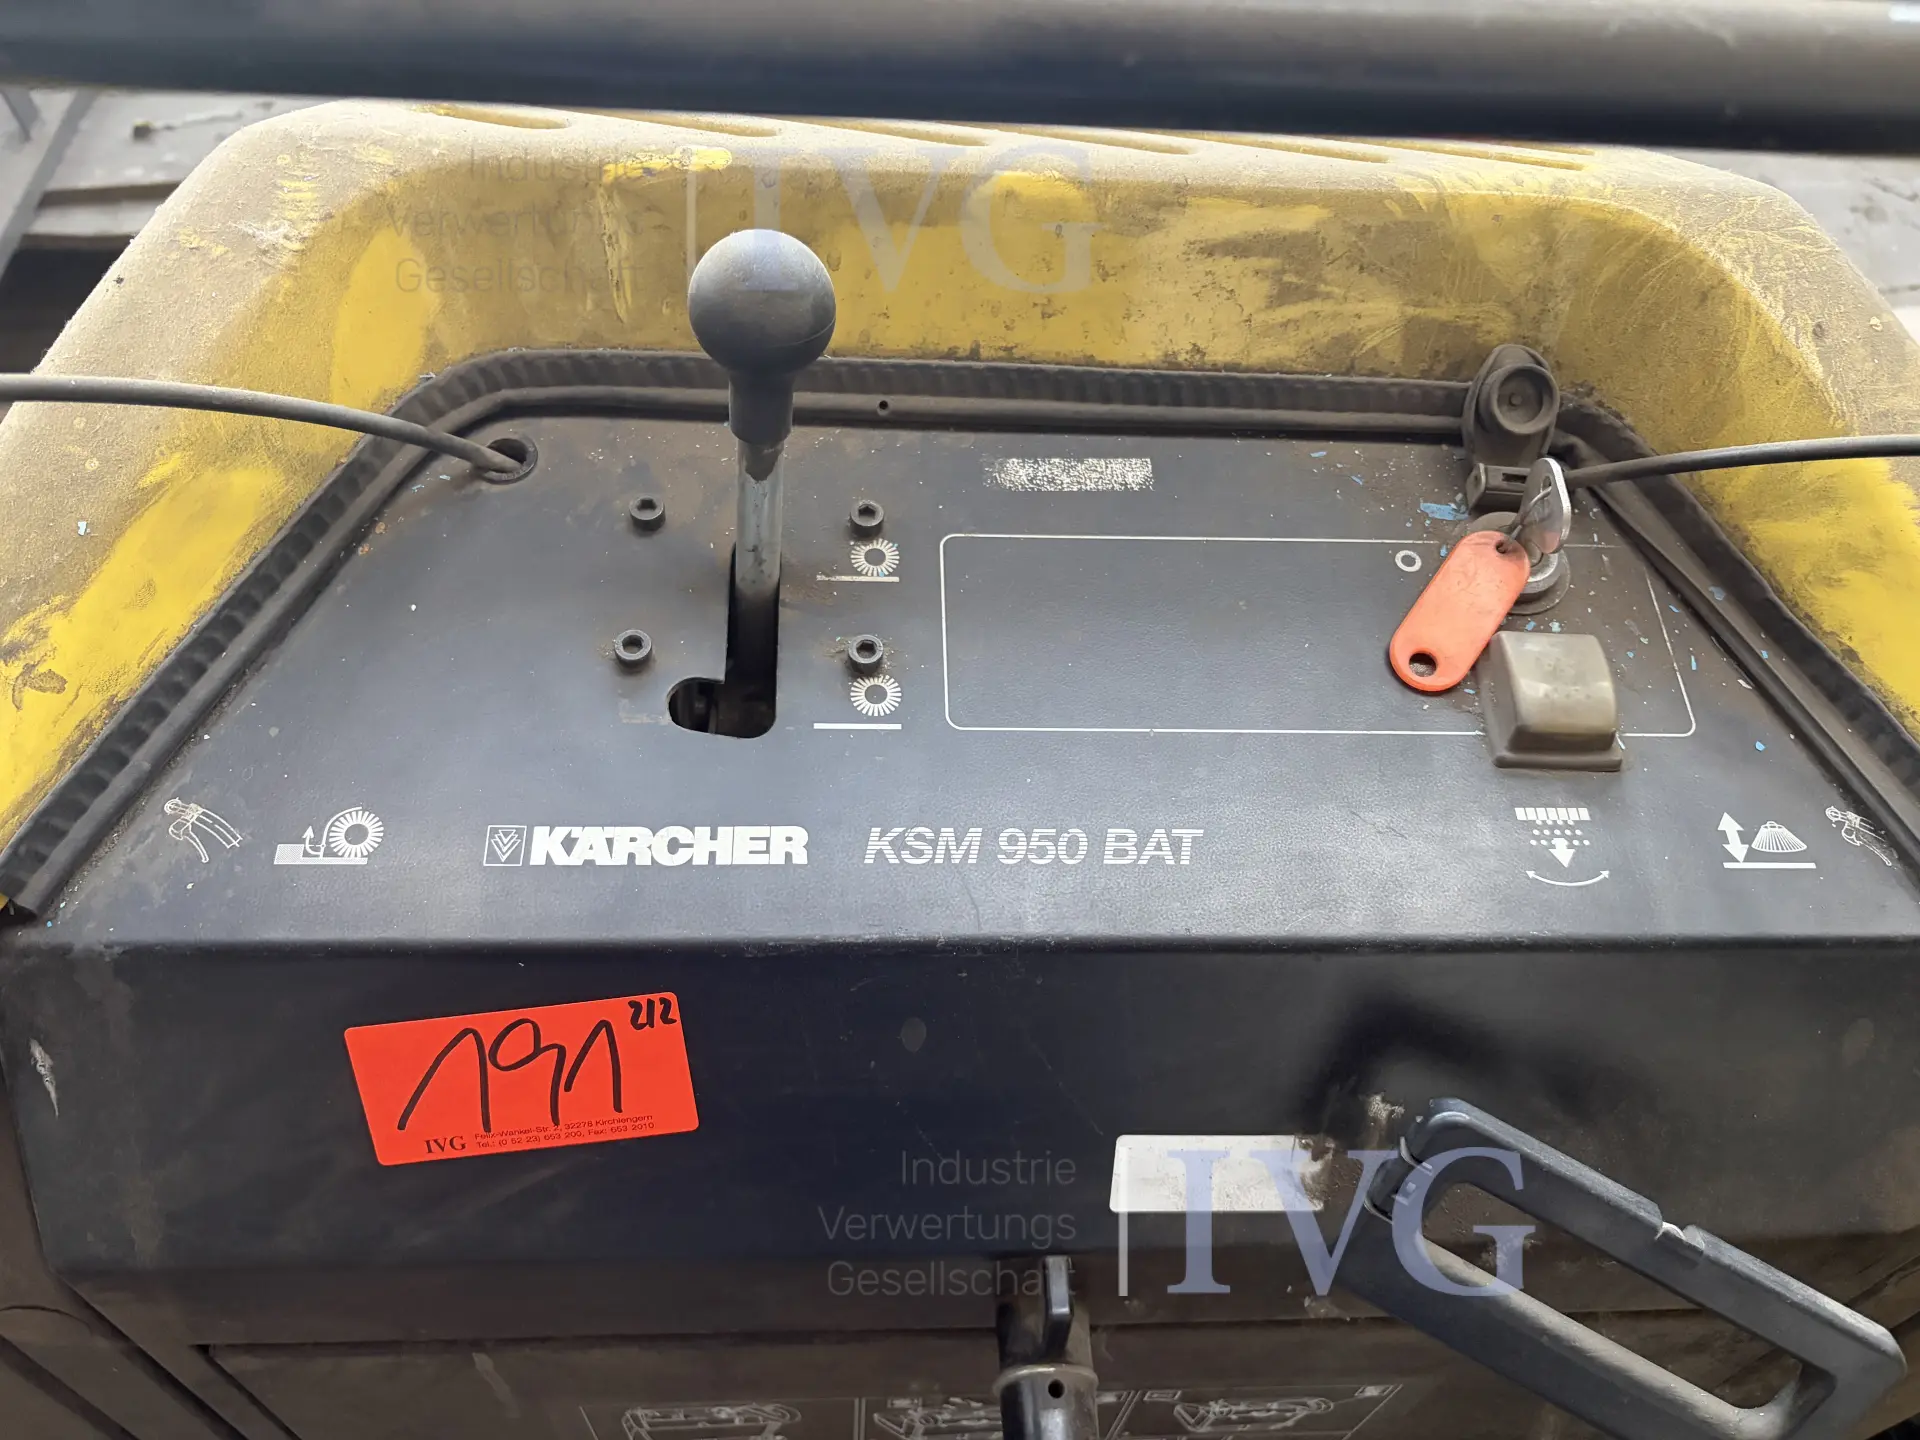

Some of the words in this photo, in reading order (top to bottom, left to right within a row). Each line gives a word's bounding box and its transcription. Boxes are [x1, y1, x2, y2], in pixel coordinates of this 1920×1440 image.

[864, 827, 983, 866] KSM
[997, 827, 1088, 866] 950
[1102, 828, 1205, 866] BAT
[474, 1125, 551, 1141] Felix-Wankel-Str.
[564, 1120, 594, 1130] 32278
[595, 1115, 654, 1126] Kirchlengern
[525, 1135, 541, 1143] 23)
[543, 1132, 562, 1141] 653
[564, 1130, 585, 1139] 200,
[588, 1128, 608, 1136] Fax:
[610, 1125, 629, 1134] 653
[631, 1122, 656, 1132] 2010
[424, 1135, 467, 1155] IVG
